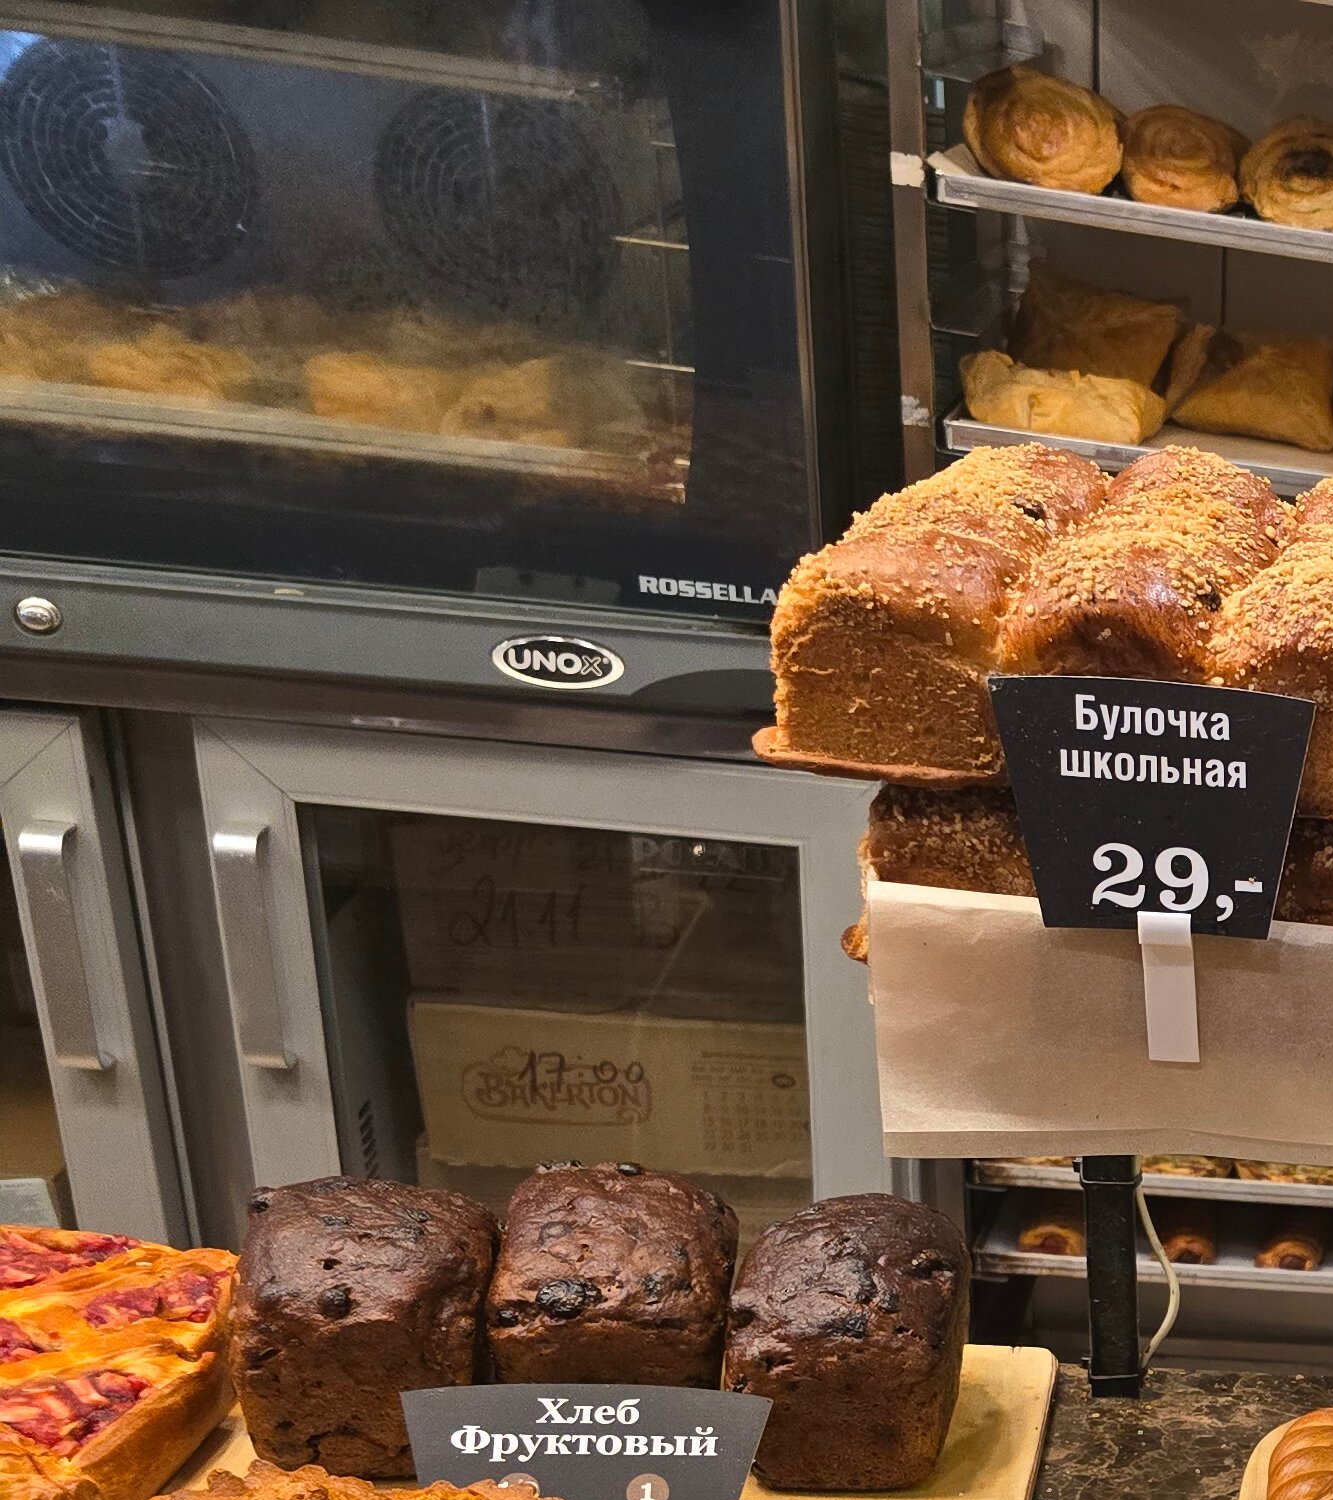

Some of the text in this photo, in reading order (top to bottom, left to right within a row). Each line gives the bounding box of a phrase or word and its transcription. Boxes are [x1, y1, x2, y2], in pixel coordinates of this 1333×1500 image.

[639, 575, 779, 605] ROSSELLA
[1075, 693, 1231, 741] Булочка
[1060, 748, 1248, 789] школьная
[1092, 843, 1263, 922] 29,-
[535, 1397, 641, 1425] Хлеб
[450, 1425, 719, 1462] Фруктовый
